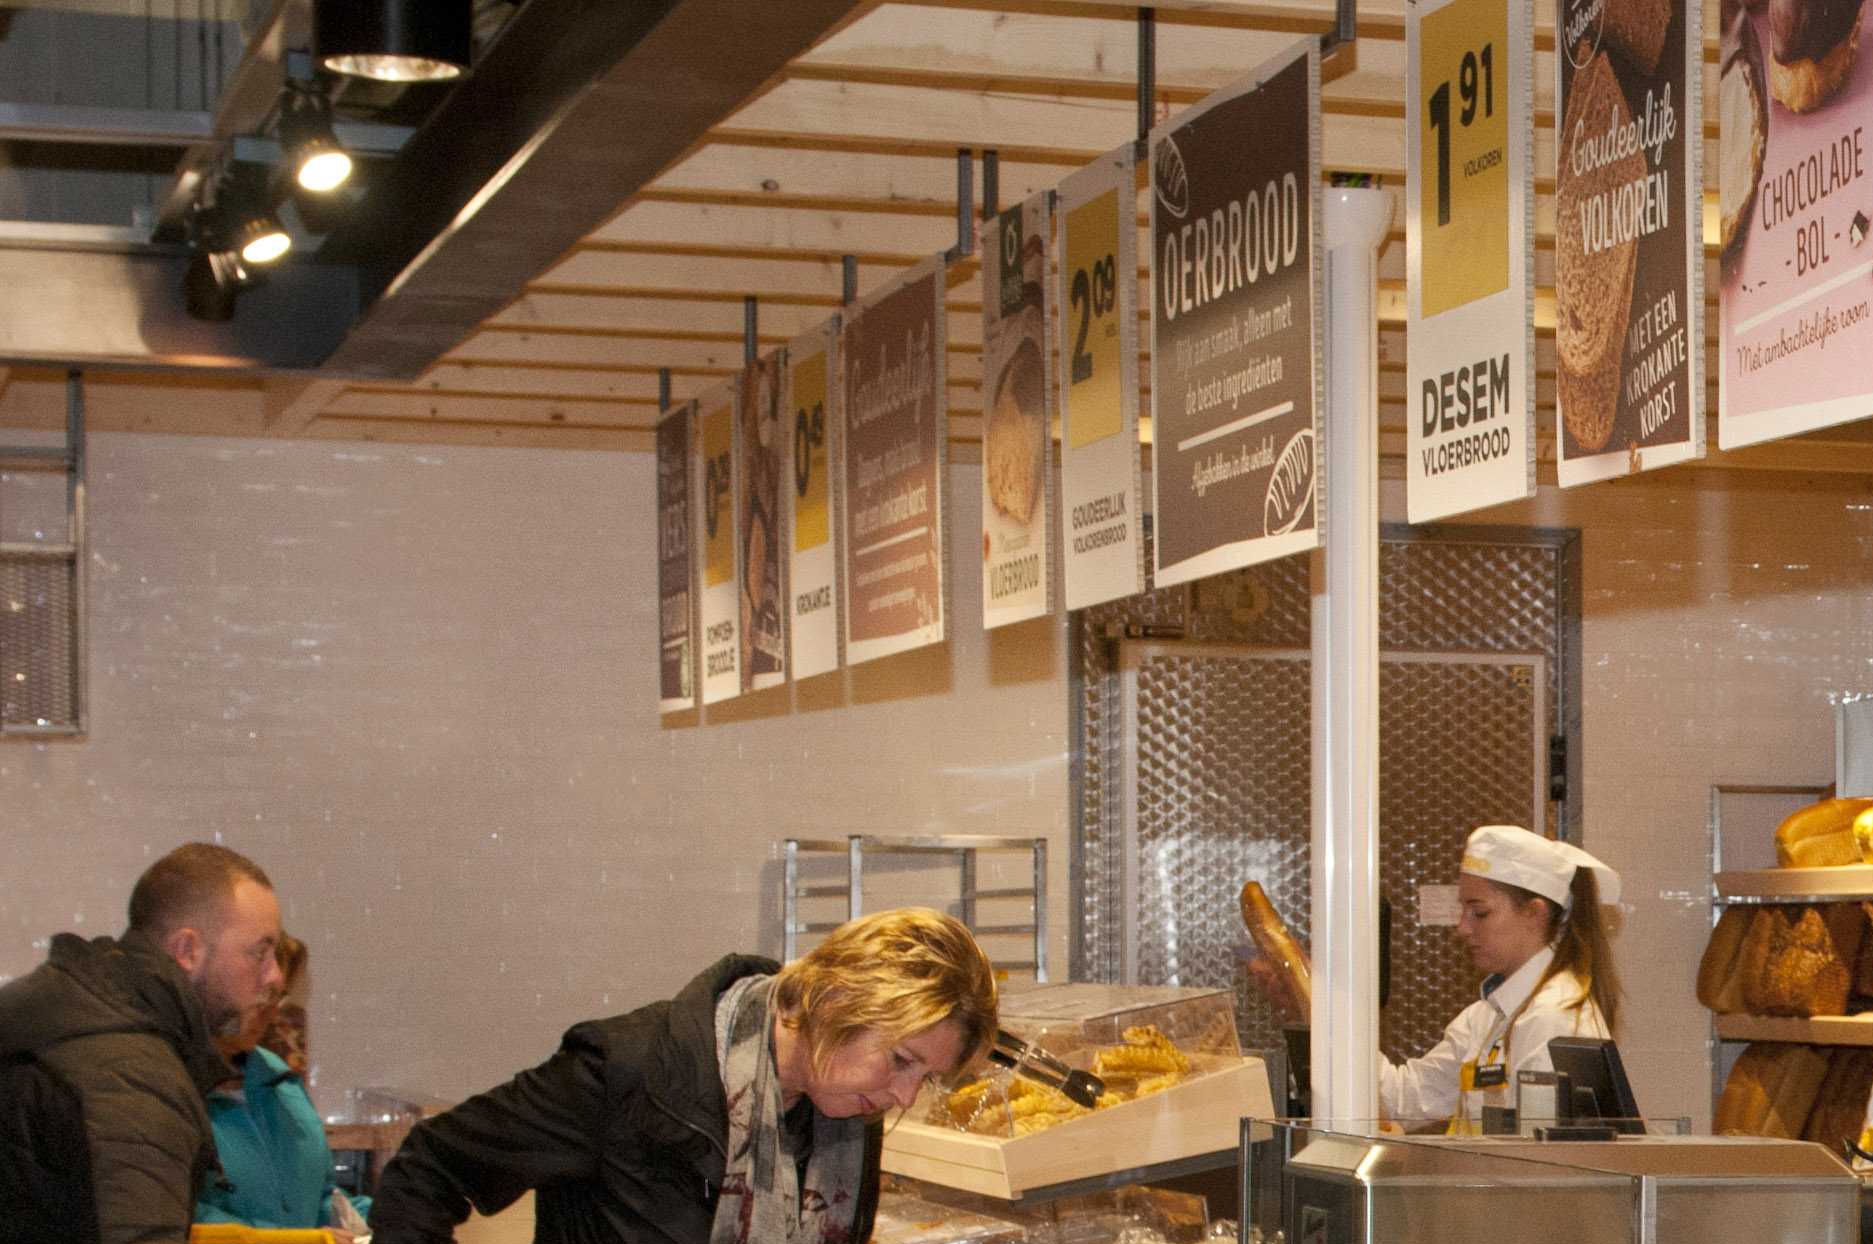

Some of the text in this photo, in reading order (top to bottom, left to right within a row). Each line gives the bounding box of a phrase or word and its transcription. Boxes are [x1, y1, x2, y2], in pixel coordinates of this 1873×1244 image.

[1463, 148, 1502, 179] VOLKOREN
[1570, 82, 1677, 176] Goudeerlijk
[1581, 170, 1668, 255] VOLKOREN
[1762, 127, 1863, 231] CHOCOLADE
[1164, 172, 1298, 320] OERBROOD
[1797, 215, 1830, 278] BOL
[1273, 295, 1292, 336] met
[1629, 292, 1678, 358] MET EEN
[1738, 301, 1871, 378] Met ambachtelijke room
[1186, 384, 1198, 416] de
[1199, 373, 1222, 411] beste
[1422, 354, 1510, 438] DESEM
[1626, 331, 1686, 406] KROKANTE
[1640, 382, 1676, 440] KORST
[1422, 427, 1510, 477] VLOERBROOD
